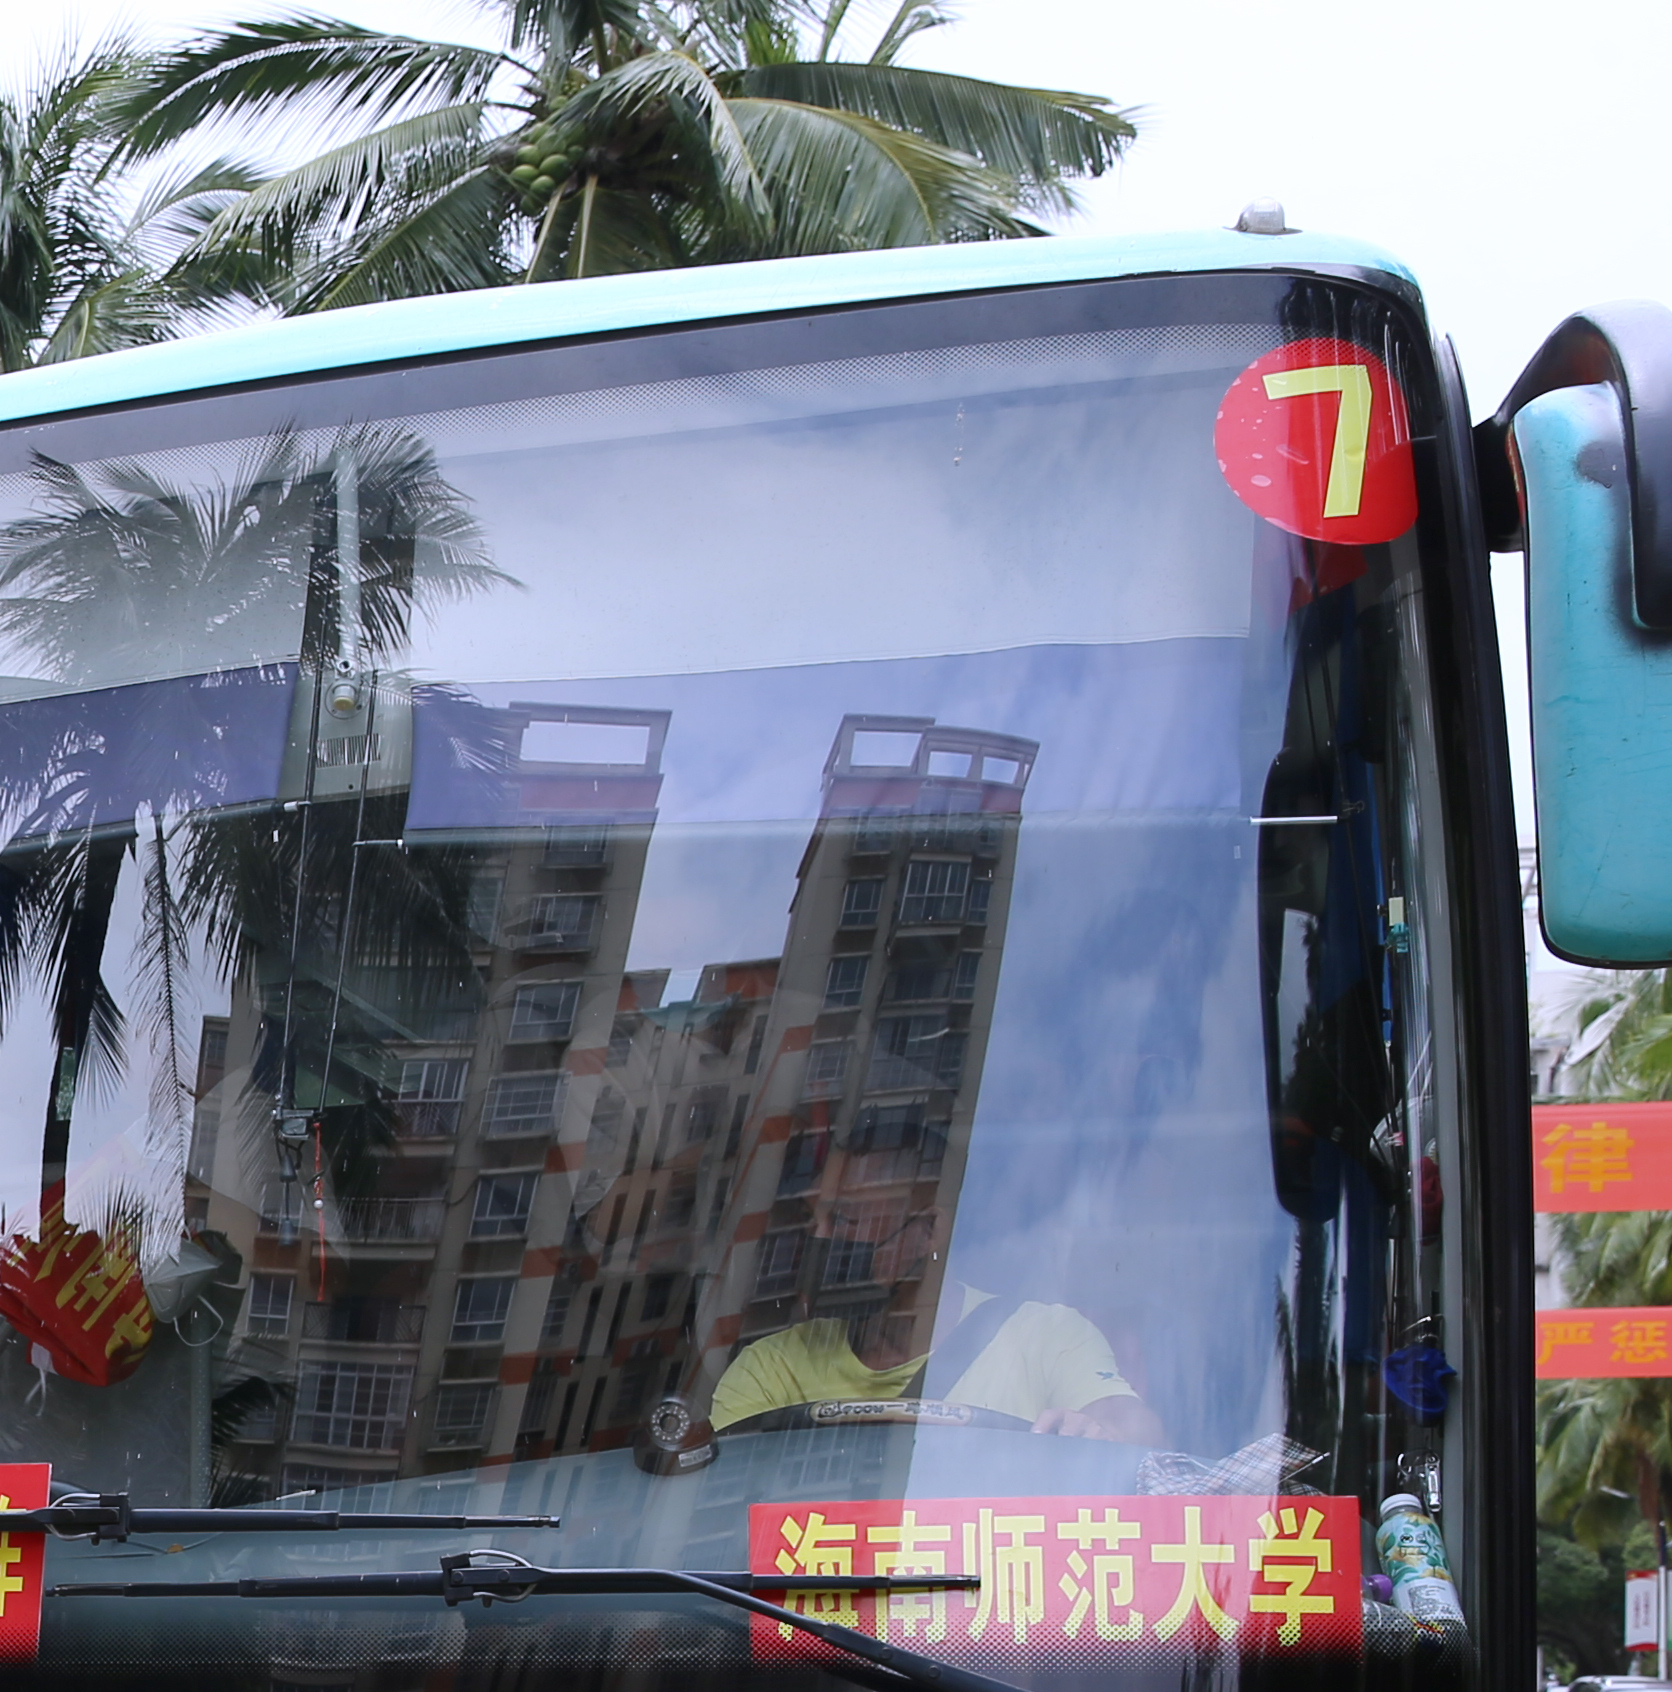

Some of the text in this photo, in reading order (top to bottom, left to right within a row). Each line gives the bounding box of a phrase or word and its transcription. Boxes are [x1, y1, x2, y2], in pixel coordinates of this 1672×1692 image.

[1262, 364, 1372, 518] 7
[1540, 1121, 1636, 1194] 律
[1537, 1320, 1668, 1365] 严惩
[774, 1505, 1335, 1648] 海南师范大学
